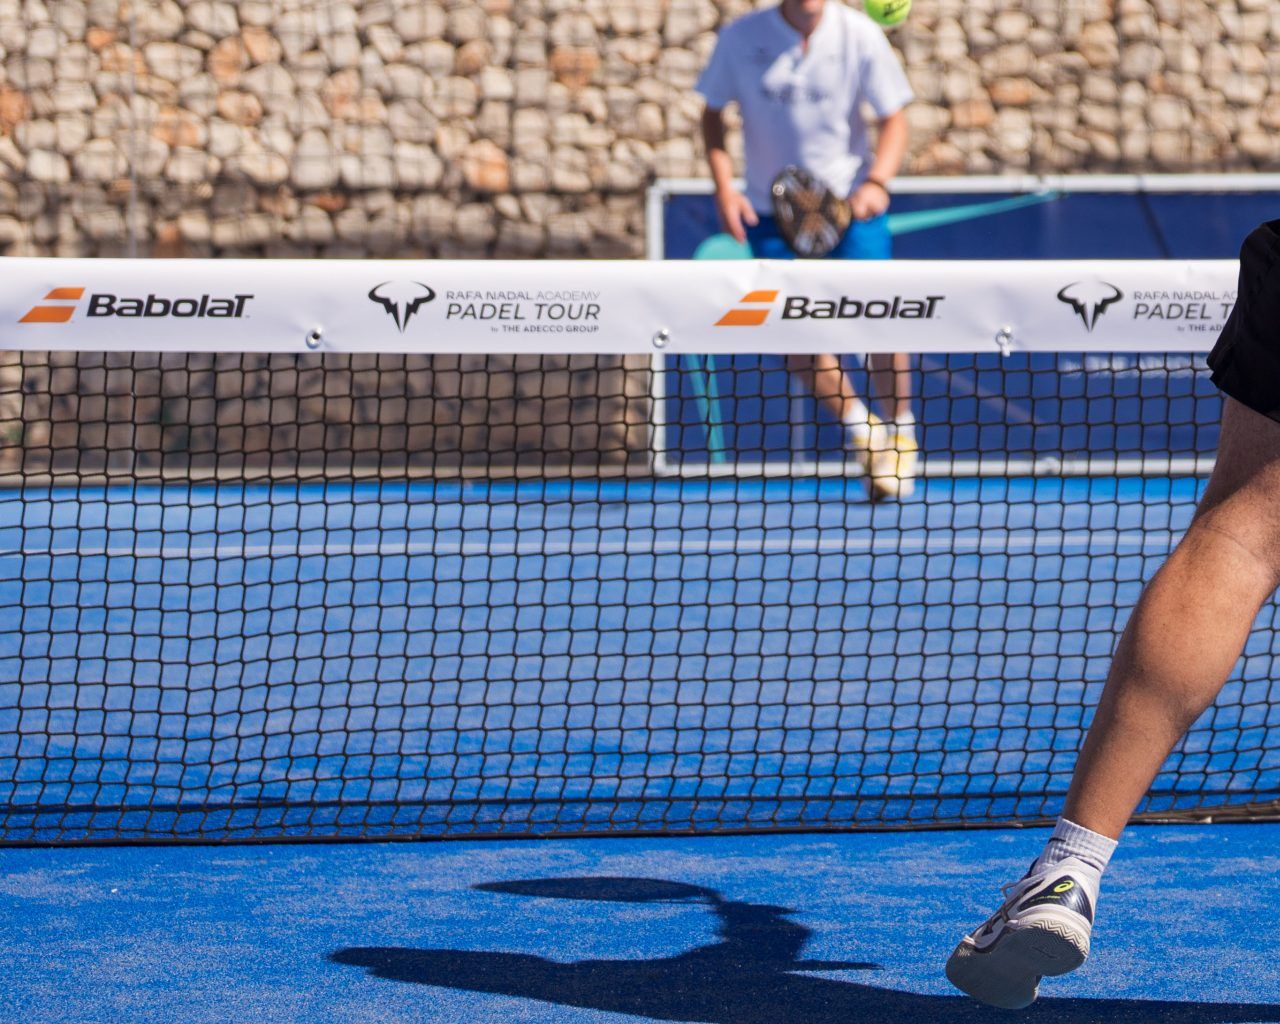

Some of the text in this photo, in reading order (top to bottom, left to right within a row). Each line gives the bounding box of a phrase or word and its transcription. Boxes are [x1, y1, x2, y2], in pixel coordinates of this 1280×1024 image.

[446, 290, 600, 302] RAFA NADAL ACADEMY
[1133, 291, 1169, 300] RAFA
[1173, 291, 1220, 300] NADAL
[446, 303, 601, 321] PADEL TOUR
[1133, 303, 1212, 320] PADEL
[502, 325, 521, 333] THE
[524, 325, 563, 333] ADECCO
[566, 325, 600, 333] GROUP
[1189, 324, 1206, 332] THE
